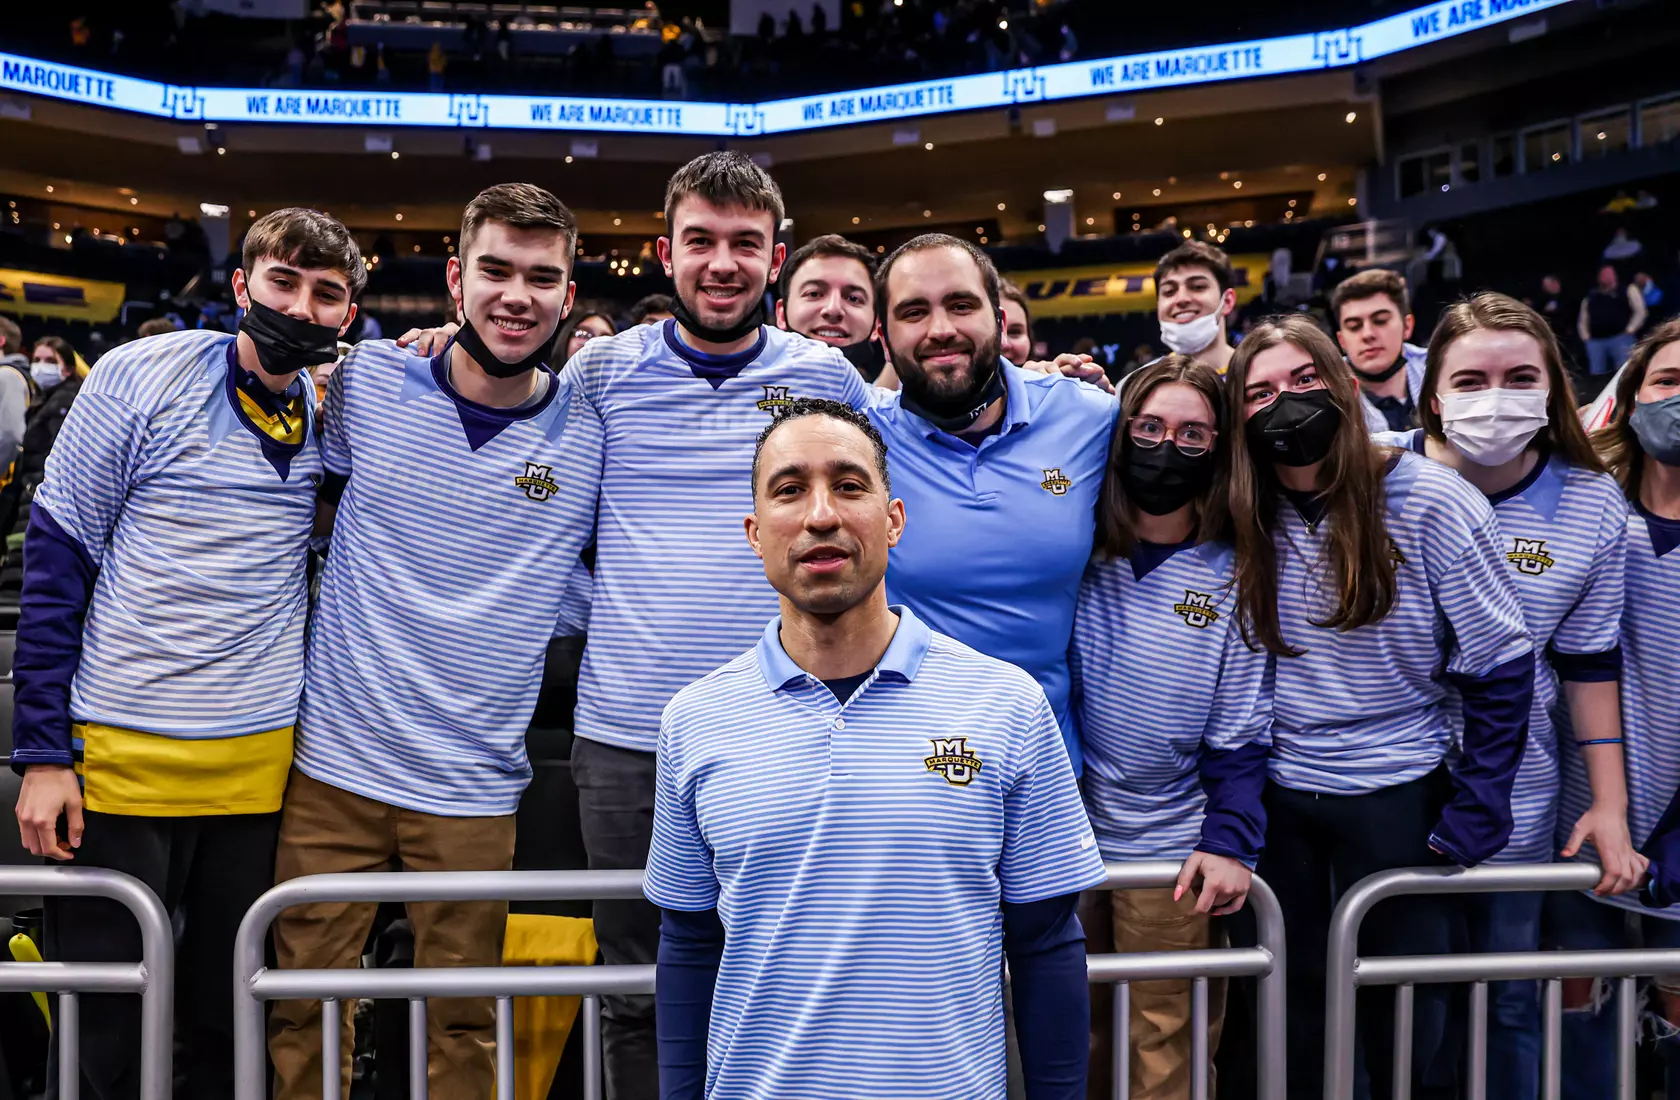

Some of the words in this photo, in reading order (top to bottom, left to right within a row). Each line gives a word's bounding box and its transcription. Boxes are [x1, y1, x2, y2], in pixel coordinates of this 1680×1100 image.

[1412, 11, 1440, 37] WE
[1448, 2, 1484, 27] ARE
[3, 61, 115, 101] MARQUETTE
[1090, 66, 1114, 86] WE
[1121, 60, 1149, 82] ARE
[1156, 46, 1262, 79] MARQUETTE
[246, 96, 269, 114] WE
[275, 96, 301, 115] ARE
[306, 97, 402, 118] MARQUETTE
[531, 104, 552, 121] WE
[559, 105, 584, 122] ARE
[590, 106, 682, 127] MARQUETTE
[803, 103, 823, 121] WE
[830, 98, 856, 117] ARE
[860, 85, 954, 114] MARQUETTE
[928, 756, 980, 769] MARQUETTE
